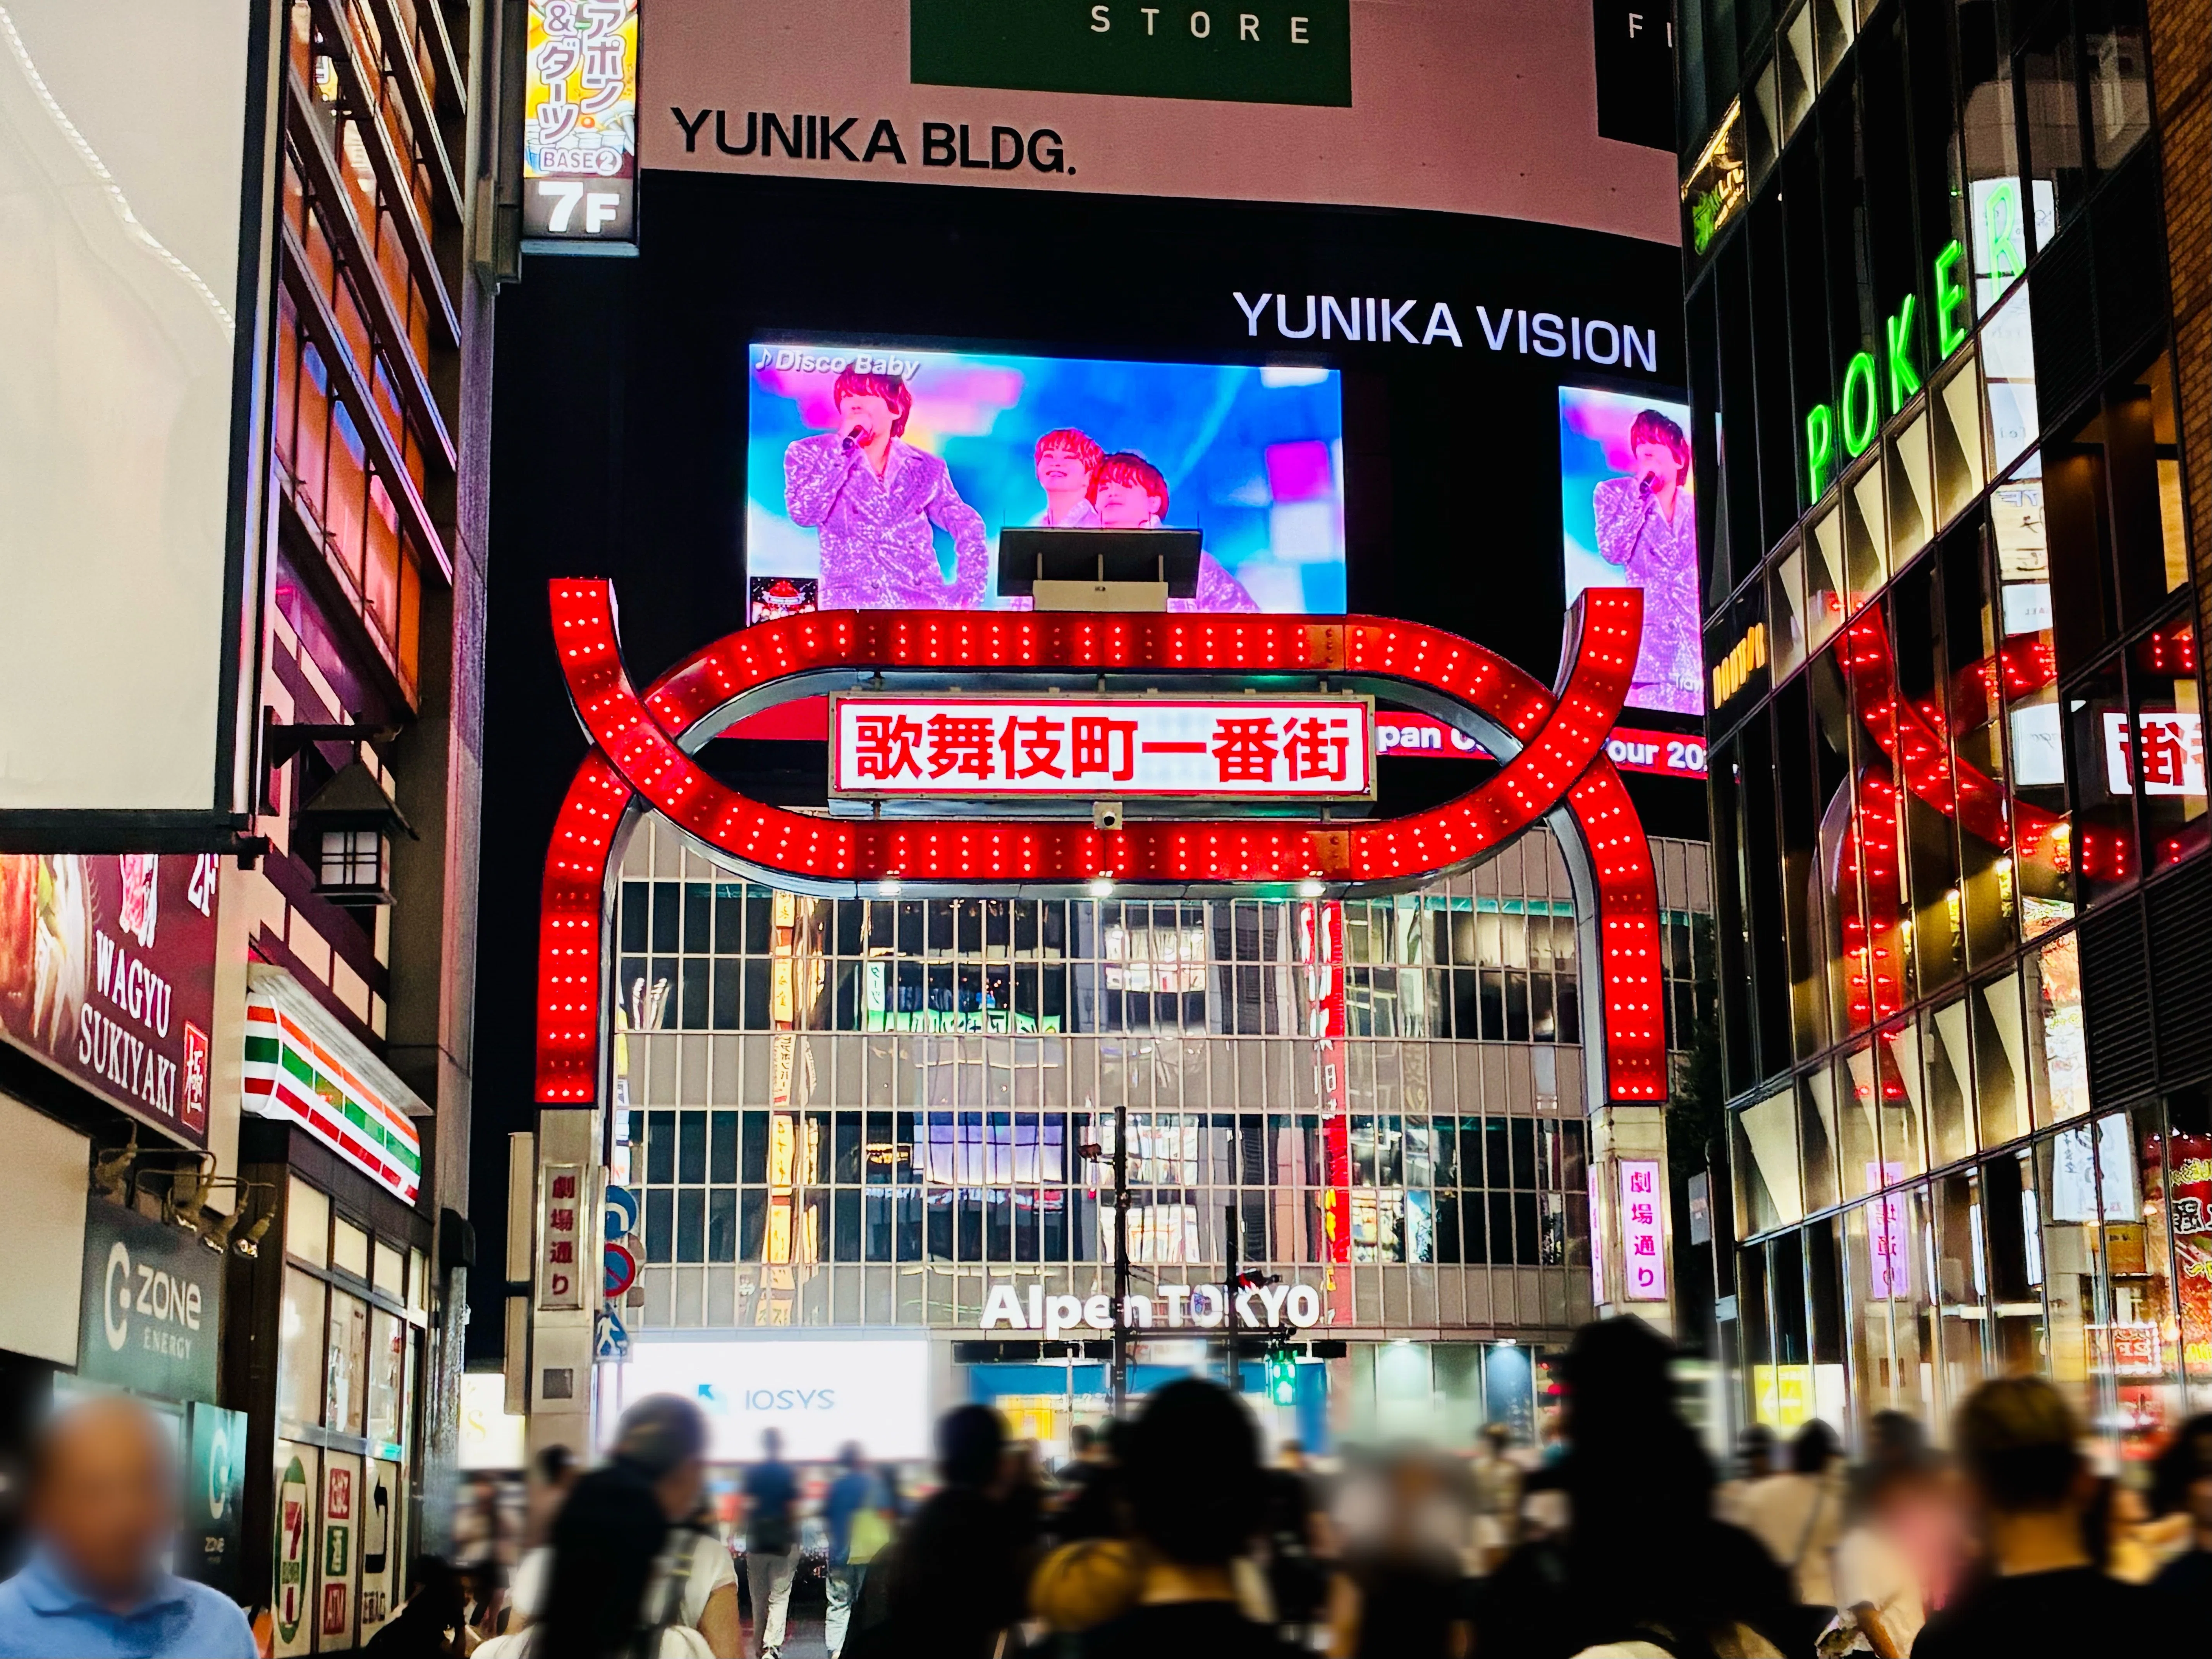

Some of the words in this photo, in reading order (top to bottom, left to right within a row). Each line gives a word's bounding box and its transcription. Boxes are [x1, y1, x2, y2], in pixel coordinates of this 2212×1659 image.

[1090, 5, 1309, 44] STORE
[670, 107, 907, 165] YUNIKA
[922, 122, 1076, 175] BLDG.
[539, 181, 620, 233] 7F
[775, 349, 847, 374] Disco
[854, 353, 921, 382] Baby
[1233, 292, 1463, 347] YUNIKA
[1476, 306, 1657, 372] VISION
[1806, 181, 2027, 505] POKER
[855, 713, 1348, 782] 歌舞伎町一番街
[1377, 725, 1442, 752] pan
[1601, 737, 1660, 765] our
[1667, 741, 1708, 772] 20
[96, 930, 172, 1038] WAGYU
[79, 1003, 177, 1117] SUKIYAKI
[550, 1176, 575, 1295] 劇場通り
[1631, 1171, 1655, 1287] 劇場通り
[143, 1327, 192, 1359] ENERGY
[744, 1389, 835, 1410] IOSYS
